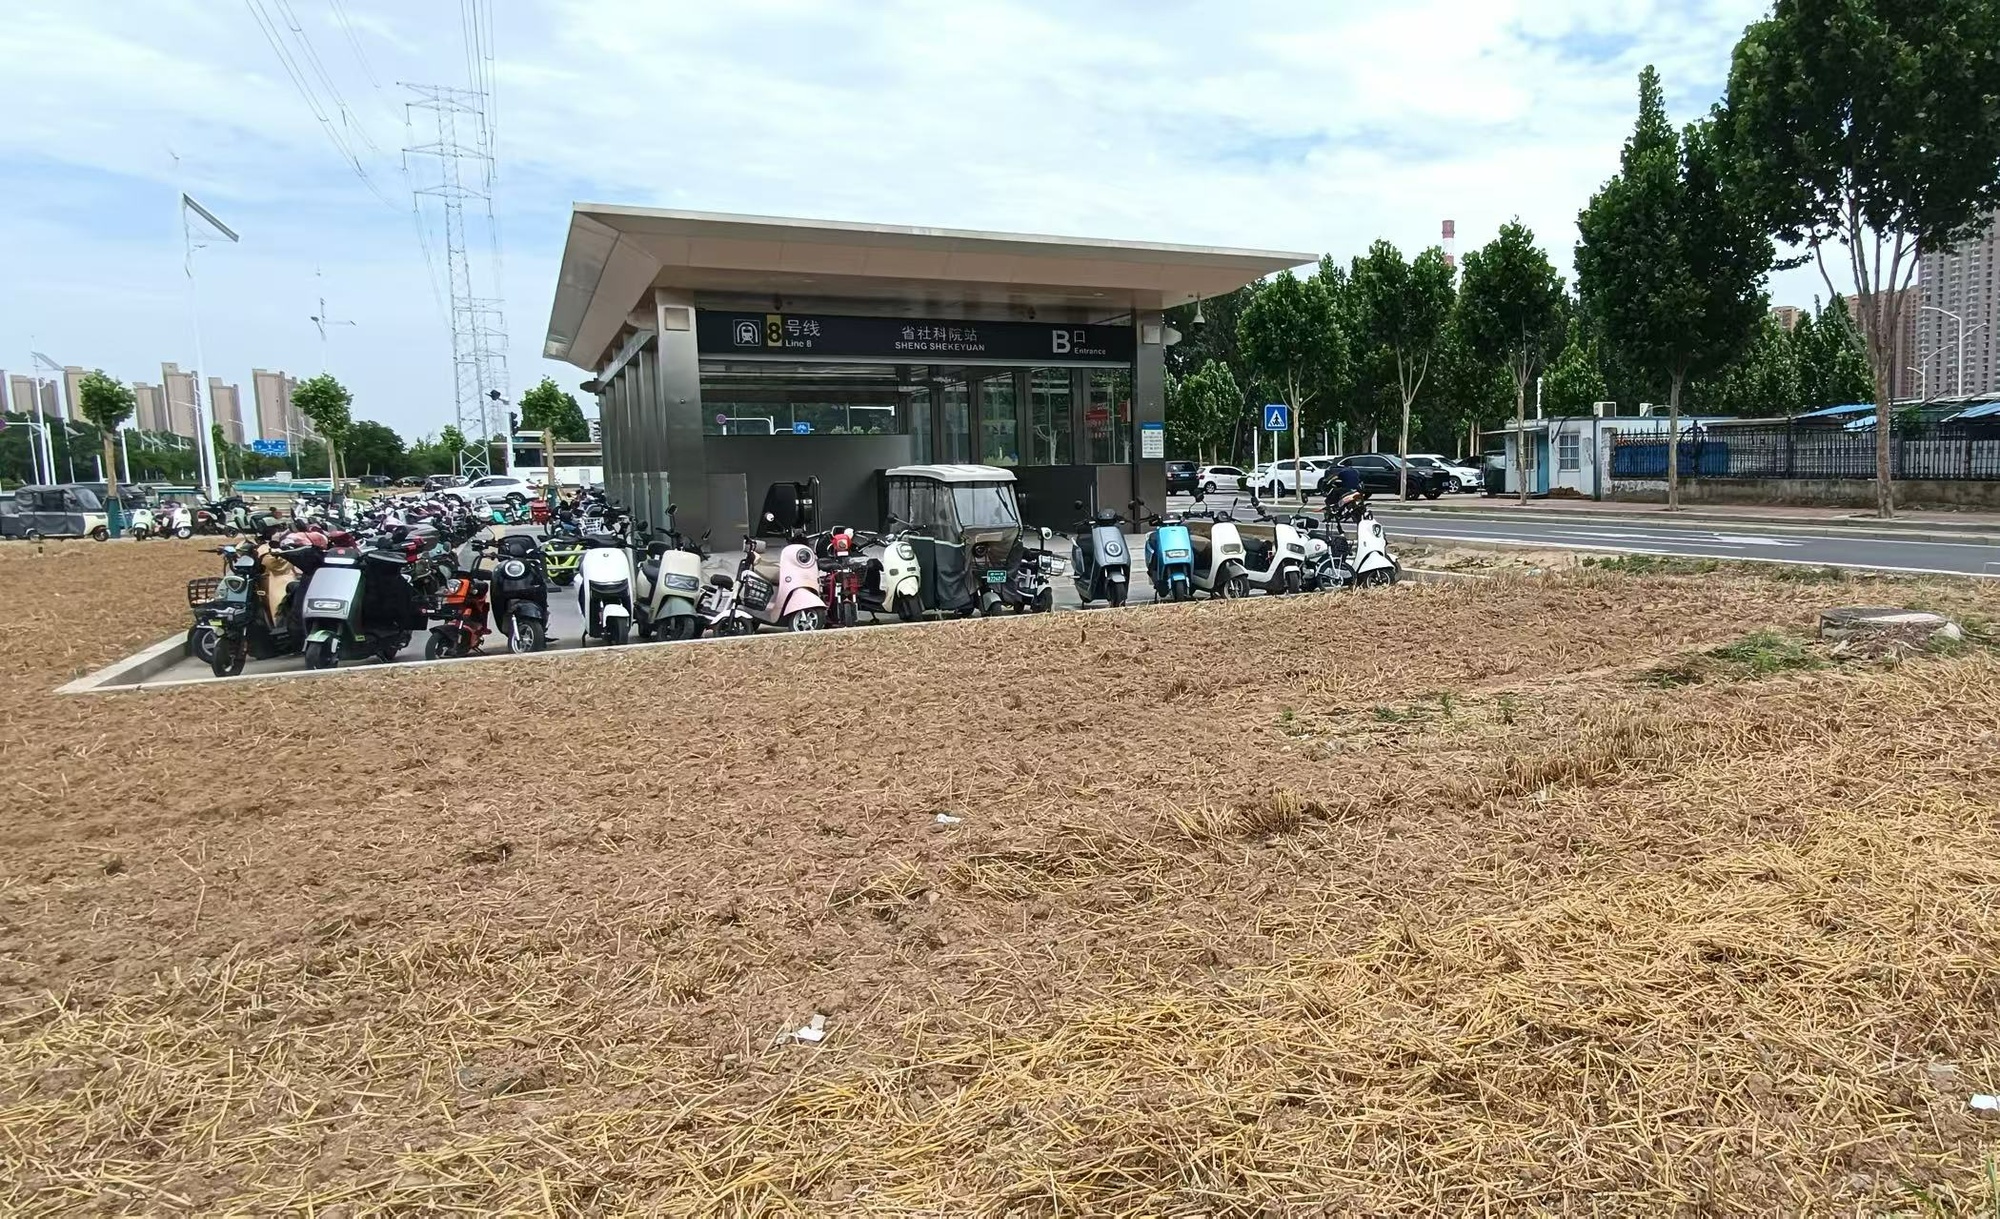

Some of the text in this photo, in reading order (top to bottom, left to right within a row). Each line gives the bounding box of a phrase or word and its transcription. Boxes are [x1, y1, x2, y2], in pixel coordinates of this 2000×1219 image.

[768, 319, 821, 343] 8 号线
[901, 325, 978, 342] 省社科院站
[785, 339, 812, 348] Line 8
[895, 341, 985, 351] SHENG SHEKEYUAN
[1052, 330, 1086, 353] B 口
[1074, 347, 1106, 355] Entrance
